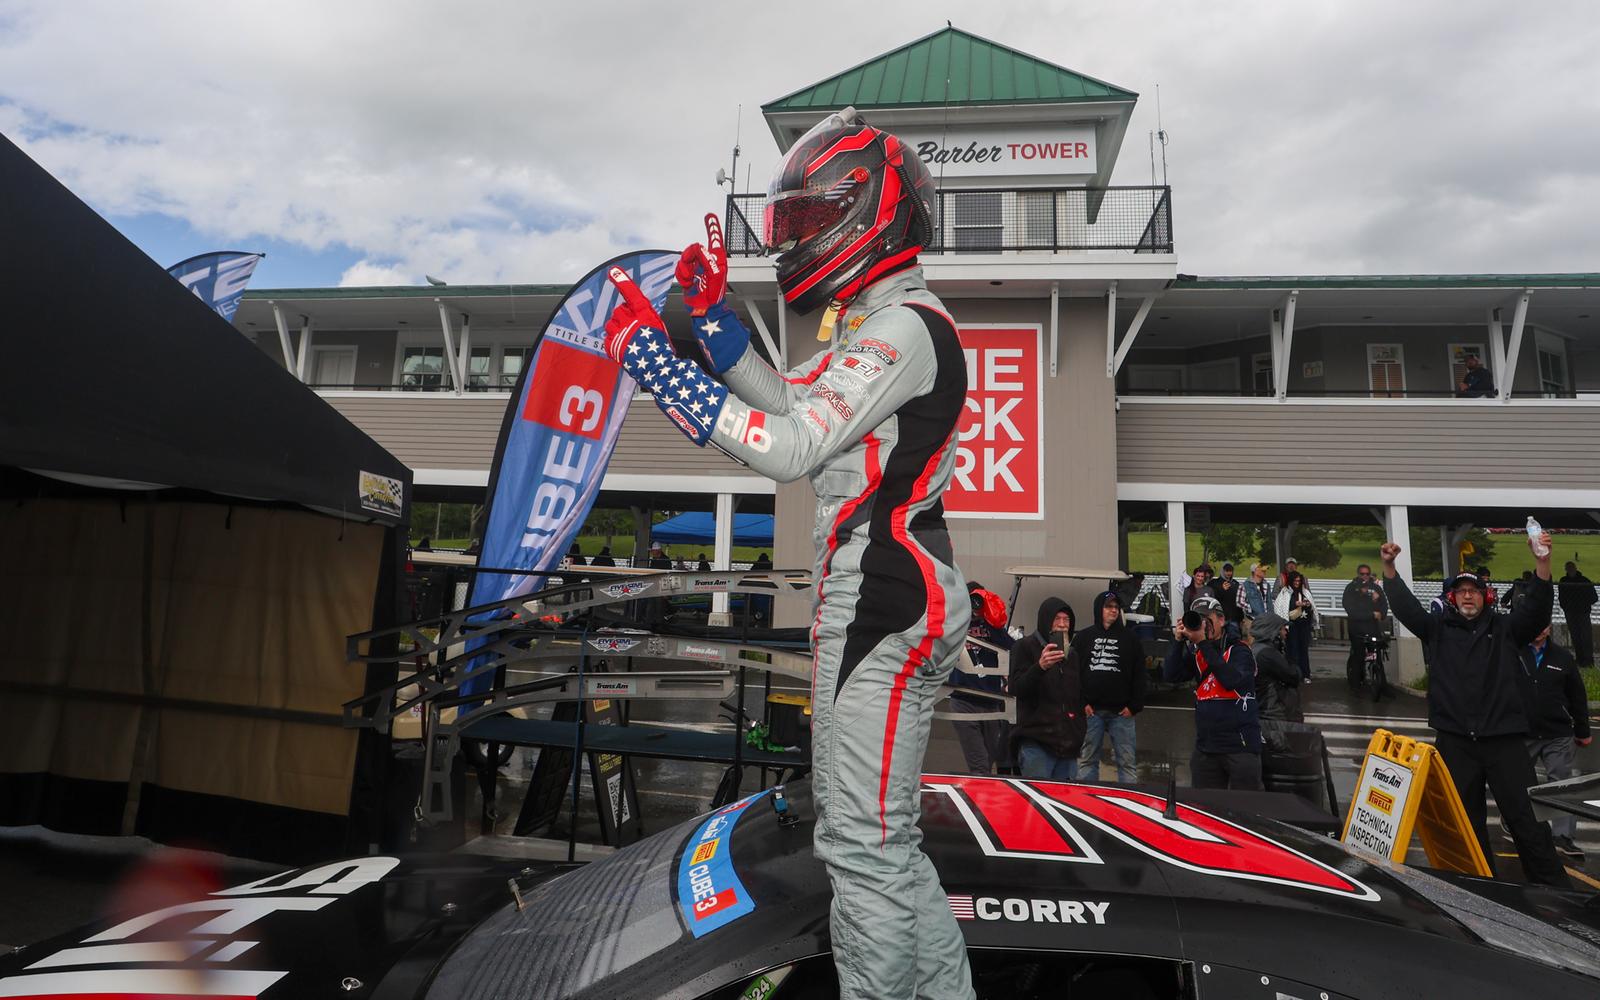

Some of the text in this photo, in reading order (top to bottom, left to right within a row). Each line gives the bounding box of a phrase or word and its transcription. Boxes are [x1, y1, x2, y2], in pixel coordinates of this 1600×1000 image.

[917, 141, 1089, 164] Barber TOWER
[555, 328, 588, 345] TITLE
[863, 347, 891, 364] RACING
[812, 383, 854, 421] BRAKES
[668, 409, 698, 436] SIMPSON
[718, 402, 773, 454] tilo
[957, 396, 1025, 442] CK
[1372, 767, 1402, 789] Trans Am
[1368, 789, 1393, 812] PIRELLI
[1355, 807, 1393, 839] TECHNICAL
[1349, 823, 1392, 858] INSPECTION
[688, 864, 718, 912] CUBE3
[975, 896, 1111, 925] CORRY
